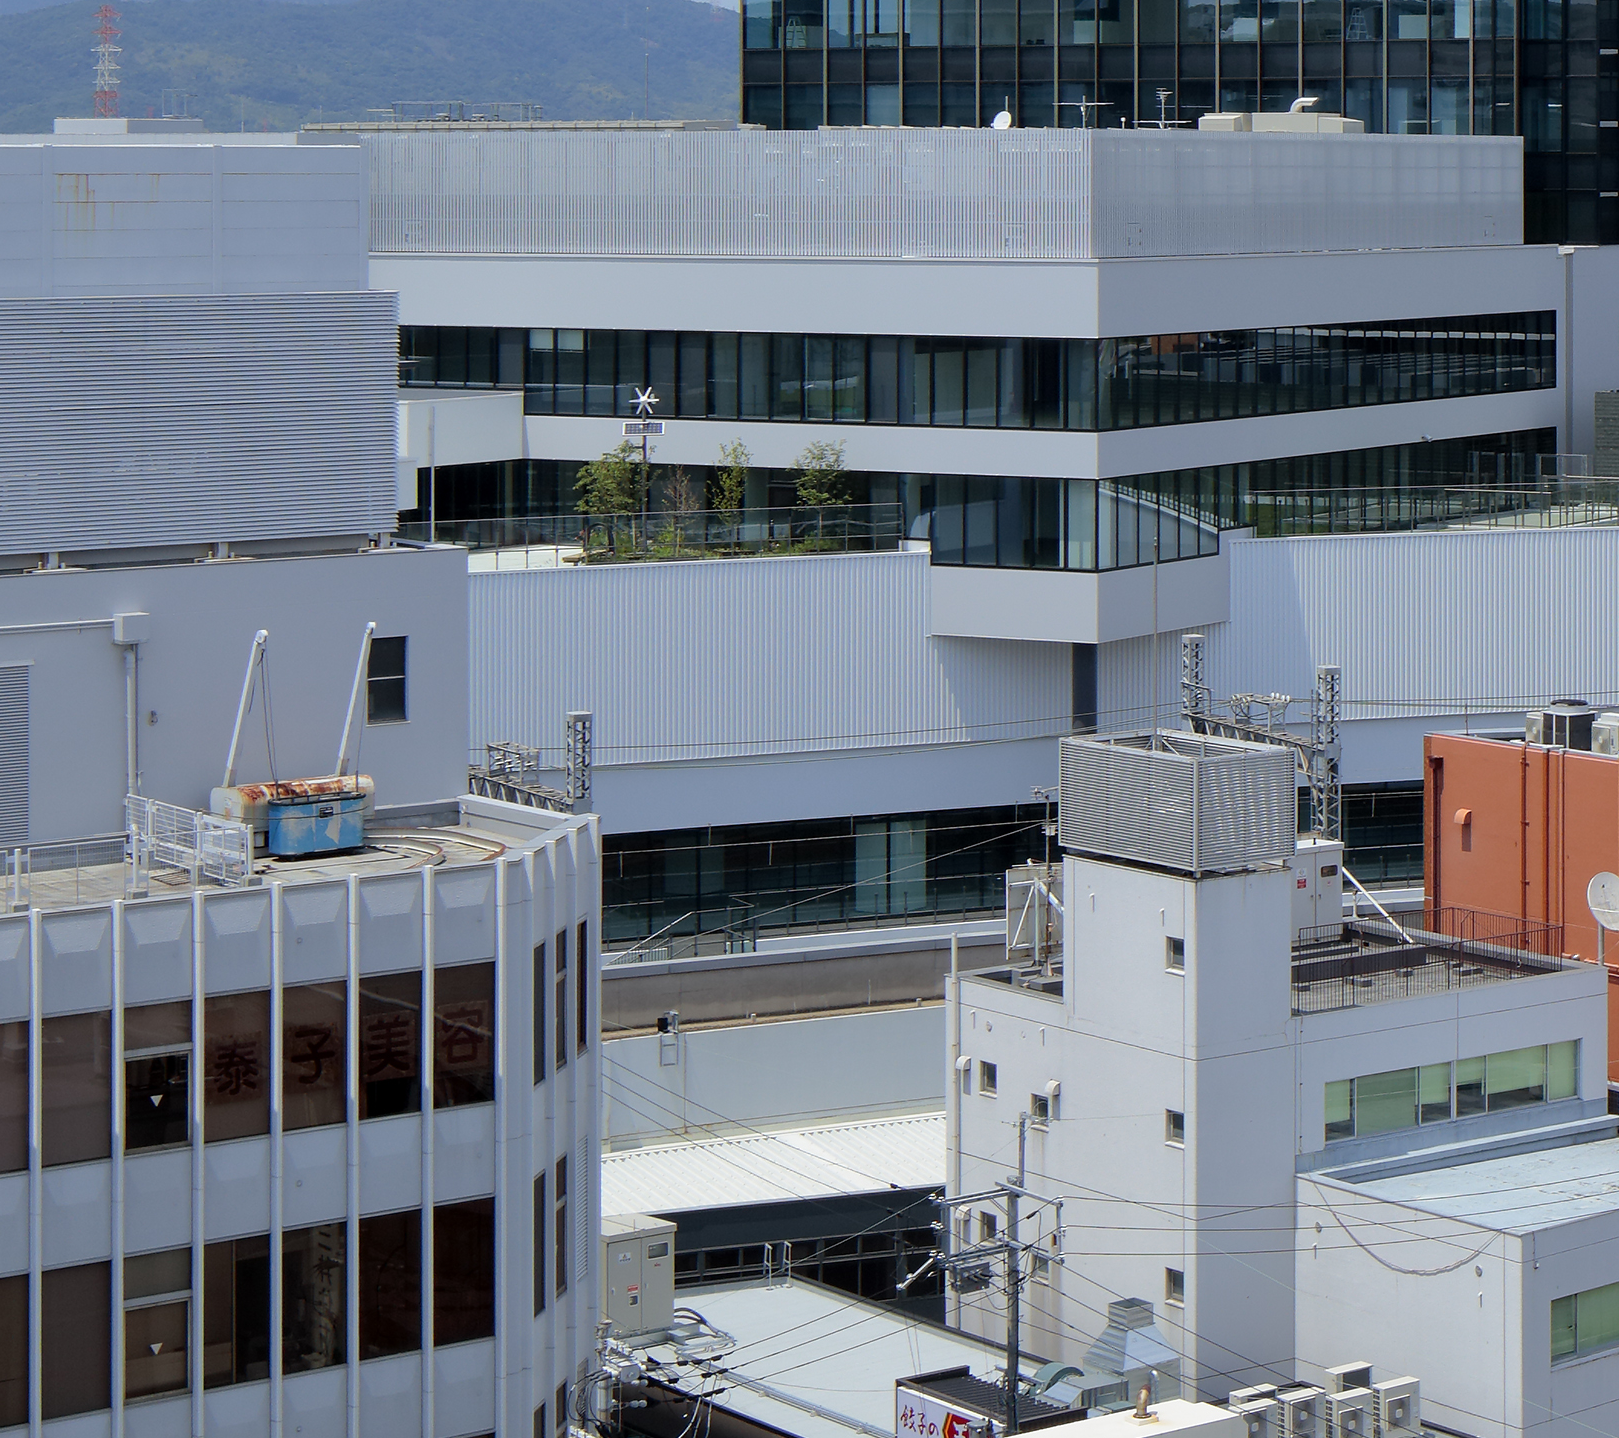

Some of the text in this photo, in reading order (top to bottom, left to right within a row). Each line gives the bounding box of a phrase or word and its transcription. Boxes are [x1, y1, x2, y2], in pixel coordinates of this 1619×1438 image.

[214, 1006, 485, 1096] 泰子美容
[901, 1405, 939, 1436] 餃子の
